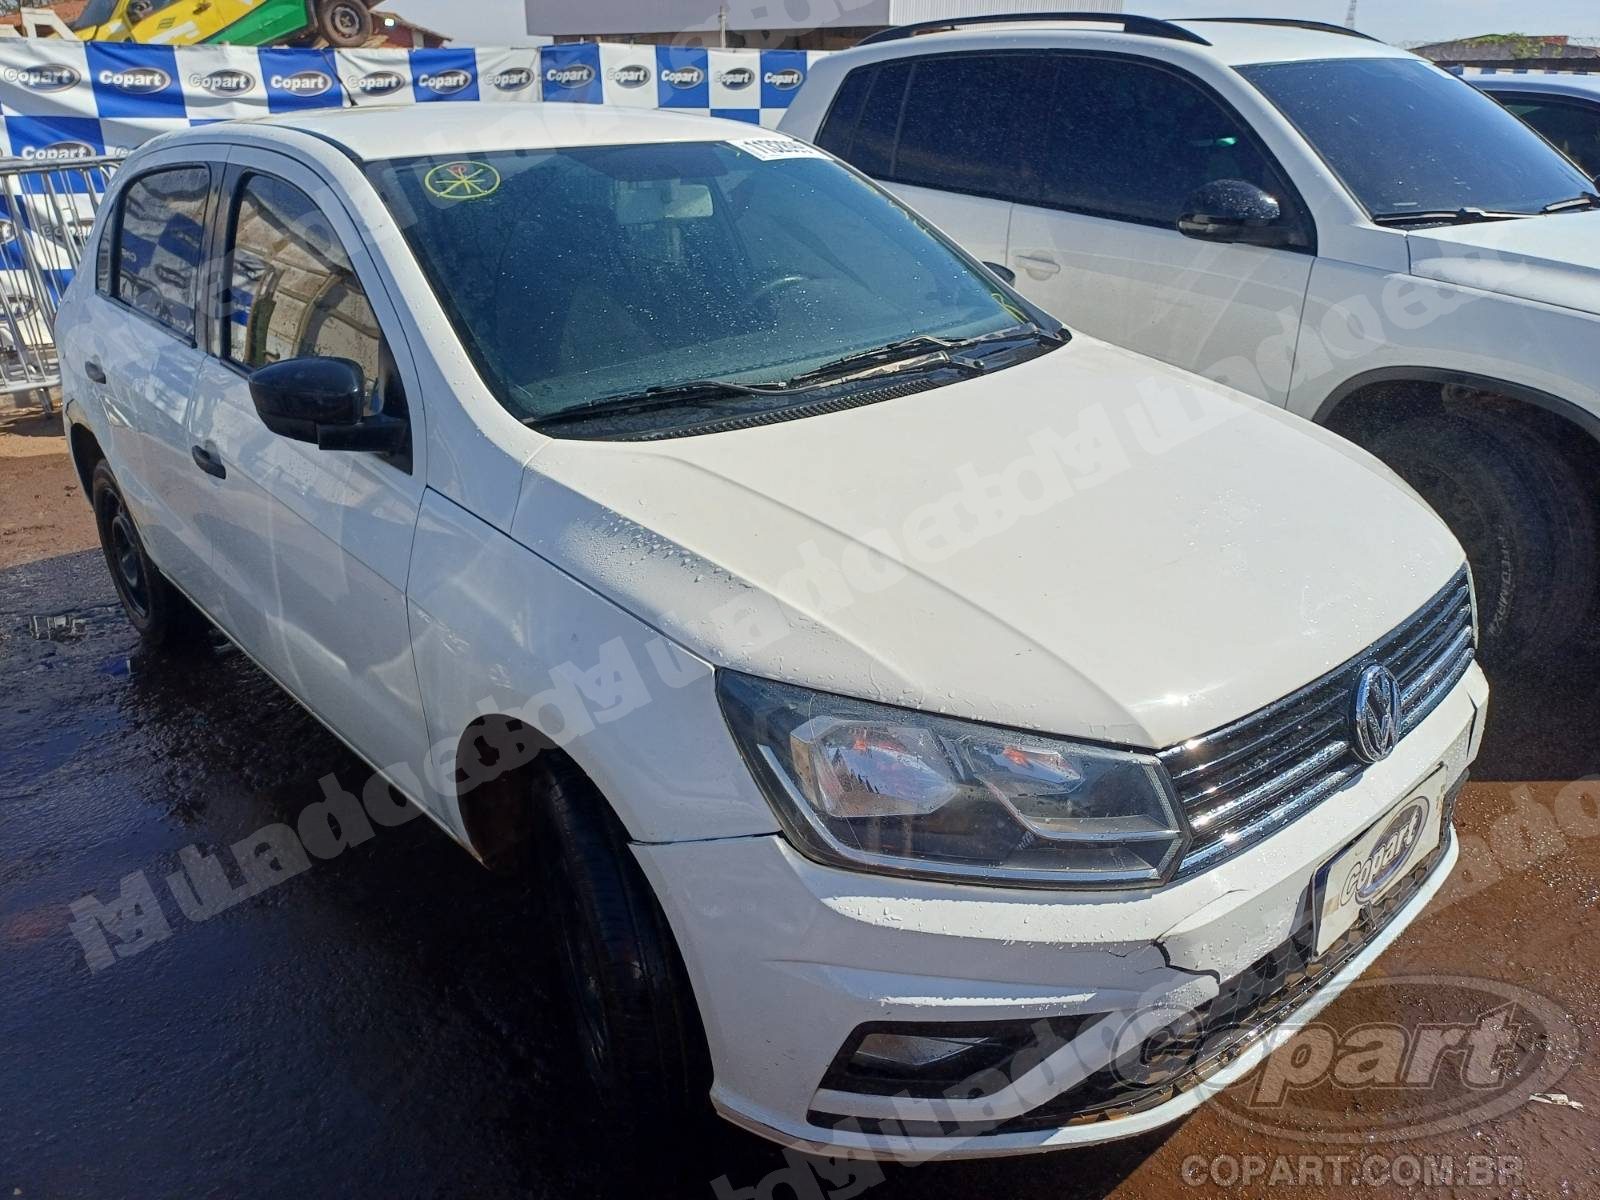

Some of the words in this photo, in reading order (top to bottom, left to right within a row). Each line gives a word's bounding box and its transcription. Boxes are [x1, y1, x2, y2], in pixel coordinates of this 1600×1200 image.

[4, 68, 70, 87] Copart
[99, 70, 162, 87] Copart
[189, 73, 247, 89] Copart
[418, 74, 466, 89] Copart
[485, 72, 528, 86] Copart
[547, 69, 589, 83] Copart
[606, 67, 645, 82] Copart
[661, 70, 699, 84] Copart
[715, 71, 751, 85] Copart
[764, 72, 799, 85] Copart
[271, 75, 324, 90] Copart
[349, 75, 397, 90] Copart
[1340, 806, 1422, 906] Copart
